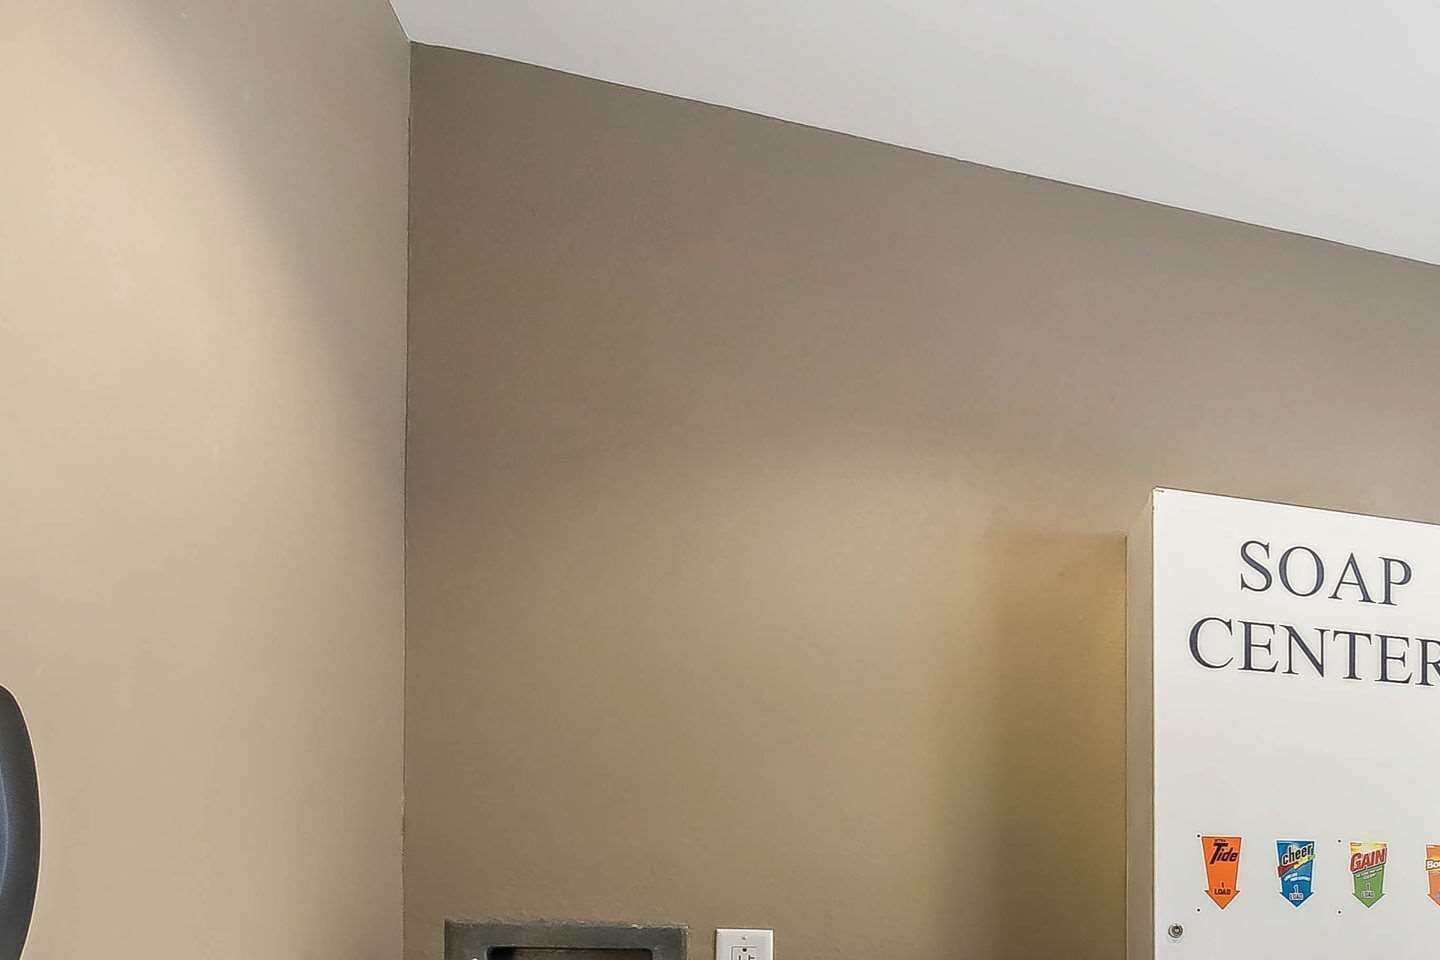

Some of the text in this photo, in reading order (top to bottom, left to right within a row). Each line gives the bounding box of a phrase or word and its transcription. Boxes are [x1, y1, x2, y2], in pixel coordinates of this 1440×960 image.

[1240, 540, 1412, 606] SOAP
[1209, 842, 1239, 865] Tide
[1282, 845, 1314, 865] cheer
[1350, 848, 1387, 872] GAIN
